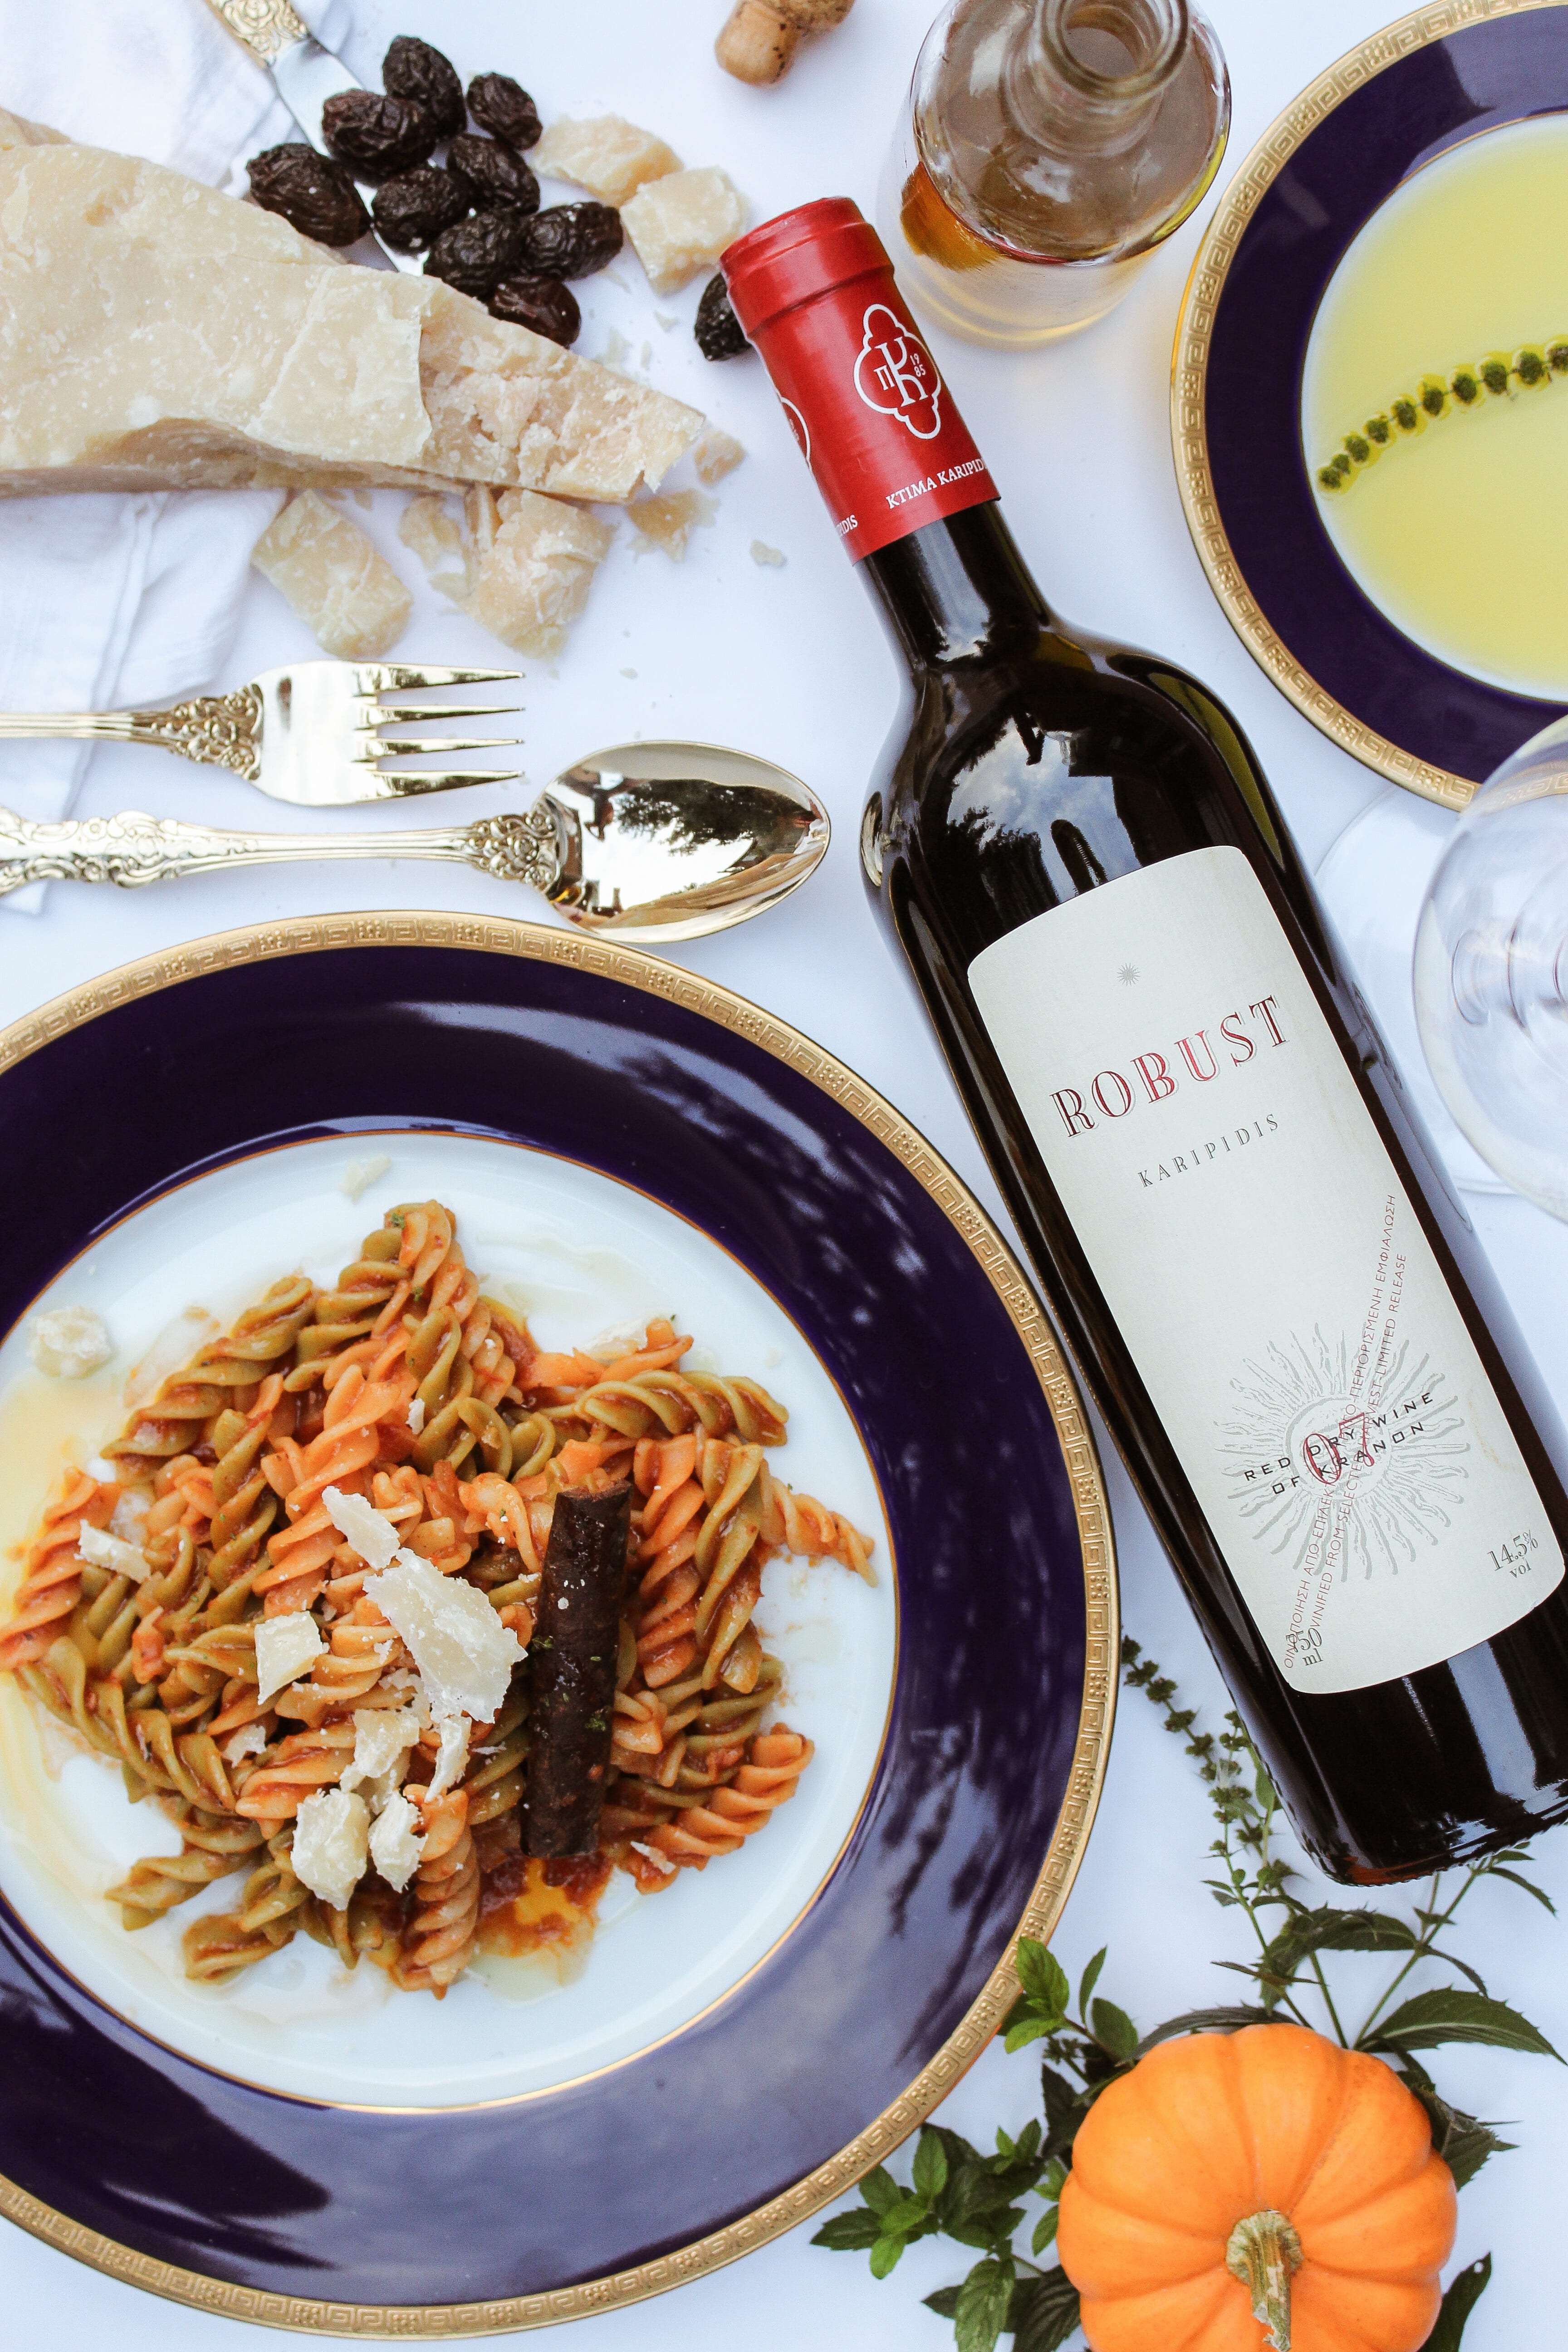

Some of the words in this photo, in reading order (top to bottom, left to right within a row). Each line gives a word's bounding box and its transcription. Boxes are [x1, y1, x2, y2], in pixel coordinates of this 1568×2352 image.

[910, 353, 920, 366] 19
[914, 364, 926, 377] 85
[885, 476, 938, 510] KTIMA
[1049, 995, 1289, 1138] ROBUST
[1137, 1113, 1279, 1188] KARIPIDIS
[1303, 1543, 1319, 1577] ΑΠΟ
[1375, 1194, 1396, 1282] ΕΜΦΙΑΛΩΣΗ
[1244, 1457, 1291, 1481] RED
[1307, 1428, 1354, 1456] DRY
[1372, 1392, 1433, 1428] WINE
[1309, 1572, 1333, 1627] VINIFIED
[1325, 1527, 1346, 1568] FROM
[1338, 1452, 1365, 1523] SELECTED
[1388, 1253, 1406, 1313] RELEASE
[1272, 1475, 1300, 1495] OF
[1486, 1529, 1538, 1571] 14.5%
[1509, 1557, 1532, 1578] vol
[1285, 1627, 1322, 1653] 750
[1302, 1647, 1323, 1666] ml
